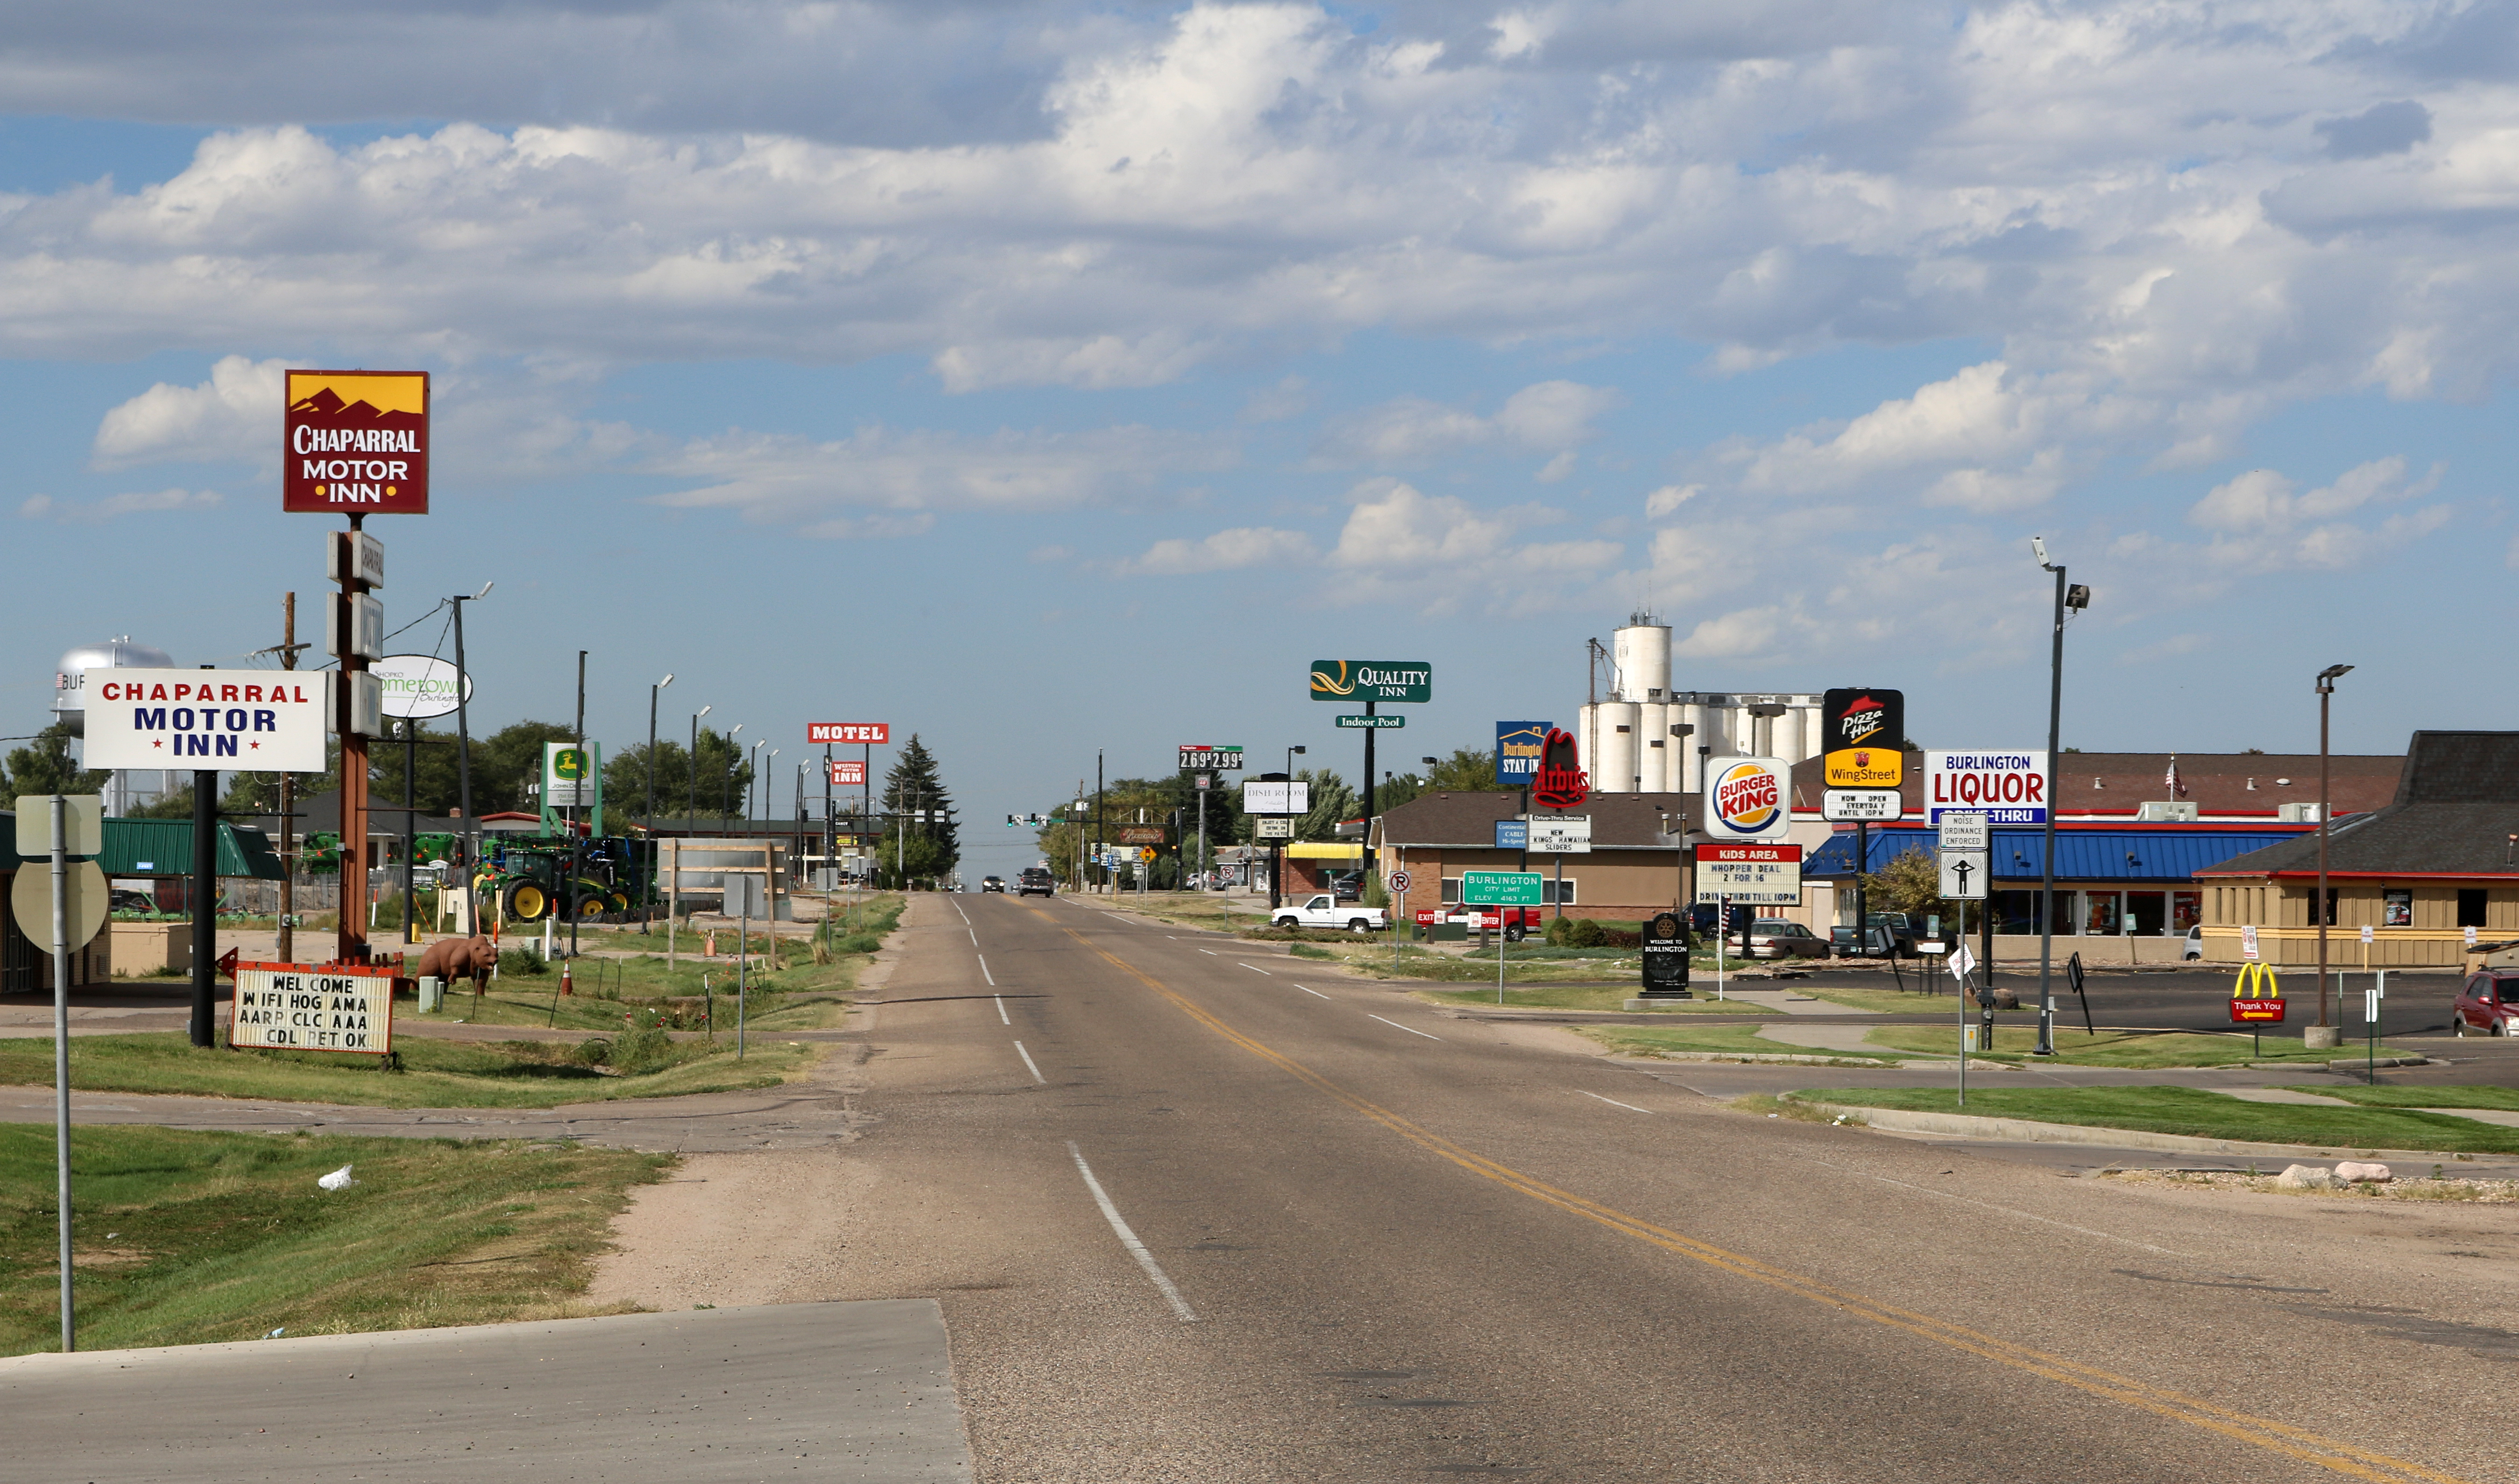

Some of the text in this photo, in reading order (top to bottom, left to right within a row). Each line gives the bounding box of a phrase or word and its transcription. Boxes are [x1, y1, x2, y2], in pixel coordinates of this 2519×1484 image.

[293, 424, 420, 455] CHAPARRAL
[303, 459, 408, 480] MOTOR
[329, 483, 381, 503] INN
[1358, 667, 1428, 686] QUALITY
[102, 683, 308, 703] CHAPARRAL
[420, 690, 459, 707] Burlingto
[1379, 687, 1407, 697] INN
[134, 708, 276, 732] MOTOR
[1342, 717, 1399, 726] Indoor Pool
[1842, 710, 1883, 735] Pizza
[813, 726, 884, 740] MOTEL
[1849, 721, 1880, 739] Hut
[173, 734, 238, 756] INN
[1503, 742, 1541, 758] Burlingto
[1503, 759, 1540, 773] STAY IN
[1946, 756, 2030, 770] BURLINGTON
[835, 772, 862, 782] INN
[1832, 769, 1896, 782] WingStreet
[1720, 775, 1775, 800] BURGER
[1934, 773, 2044, 806] LIQUOR
[1722, 787, 1778, 819] KING
[1748, 850, 1779, 860] AREA
[1468, 876, 1537, 885] BURLINGTON
[290, 995, 322, 1010] HOG
[332, 997, 367, 1012] AMA
[240, 1010, 367, 1030] AARP CLC AAA
[267, 1029, 367, 1047] CDL PET OK
